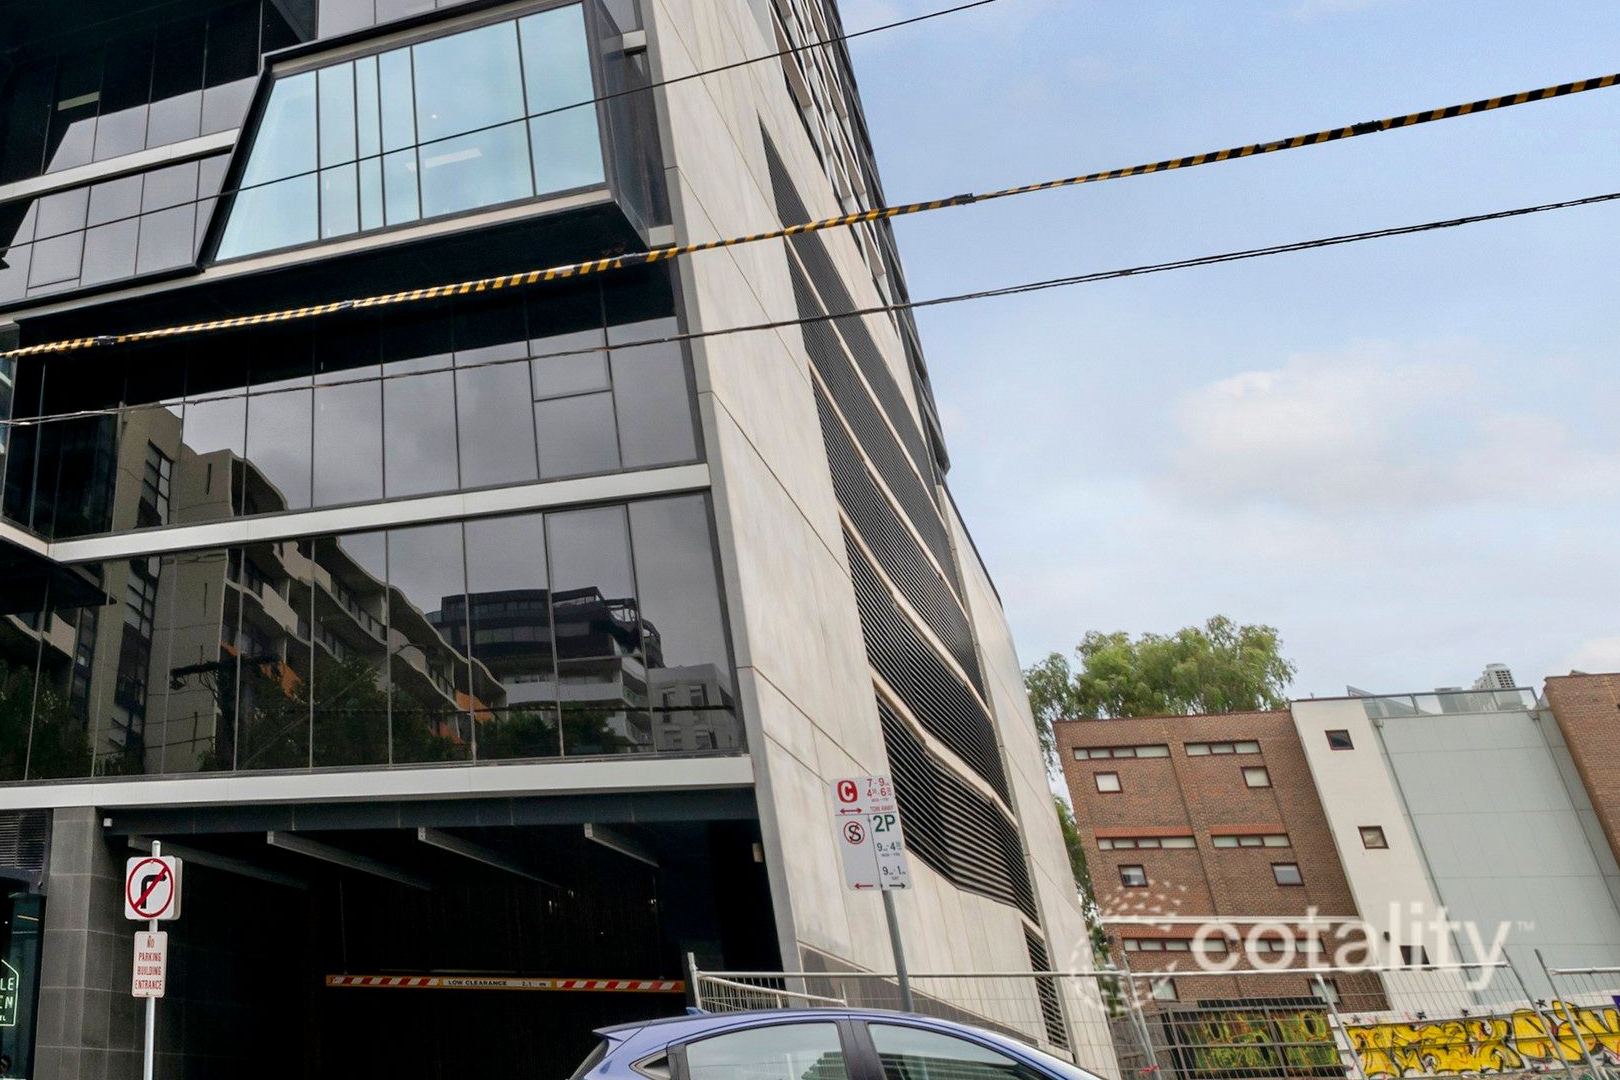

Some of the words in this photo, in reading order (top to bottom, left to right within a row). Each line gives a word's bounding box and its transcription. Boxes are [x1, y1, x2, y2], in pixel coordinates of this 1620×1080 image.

[873, 815, 896, 832] 2P
[147, 938, 155, 949] NO
[139, 952, 162, 961] PARKING
[137, 966, 162, 976] BUILDING
[135, 980, 163, 990] ENTRANCE
